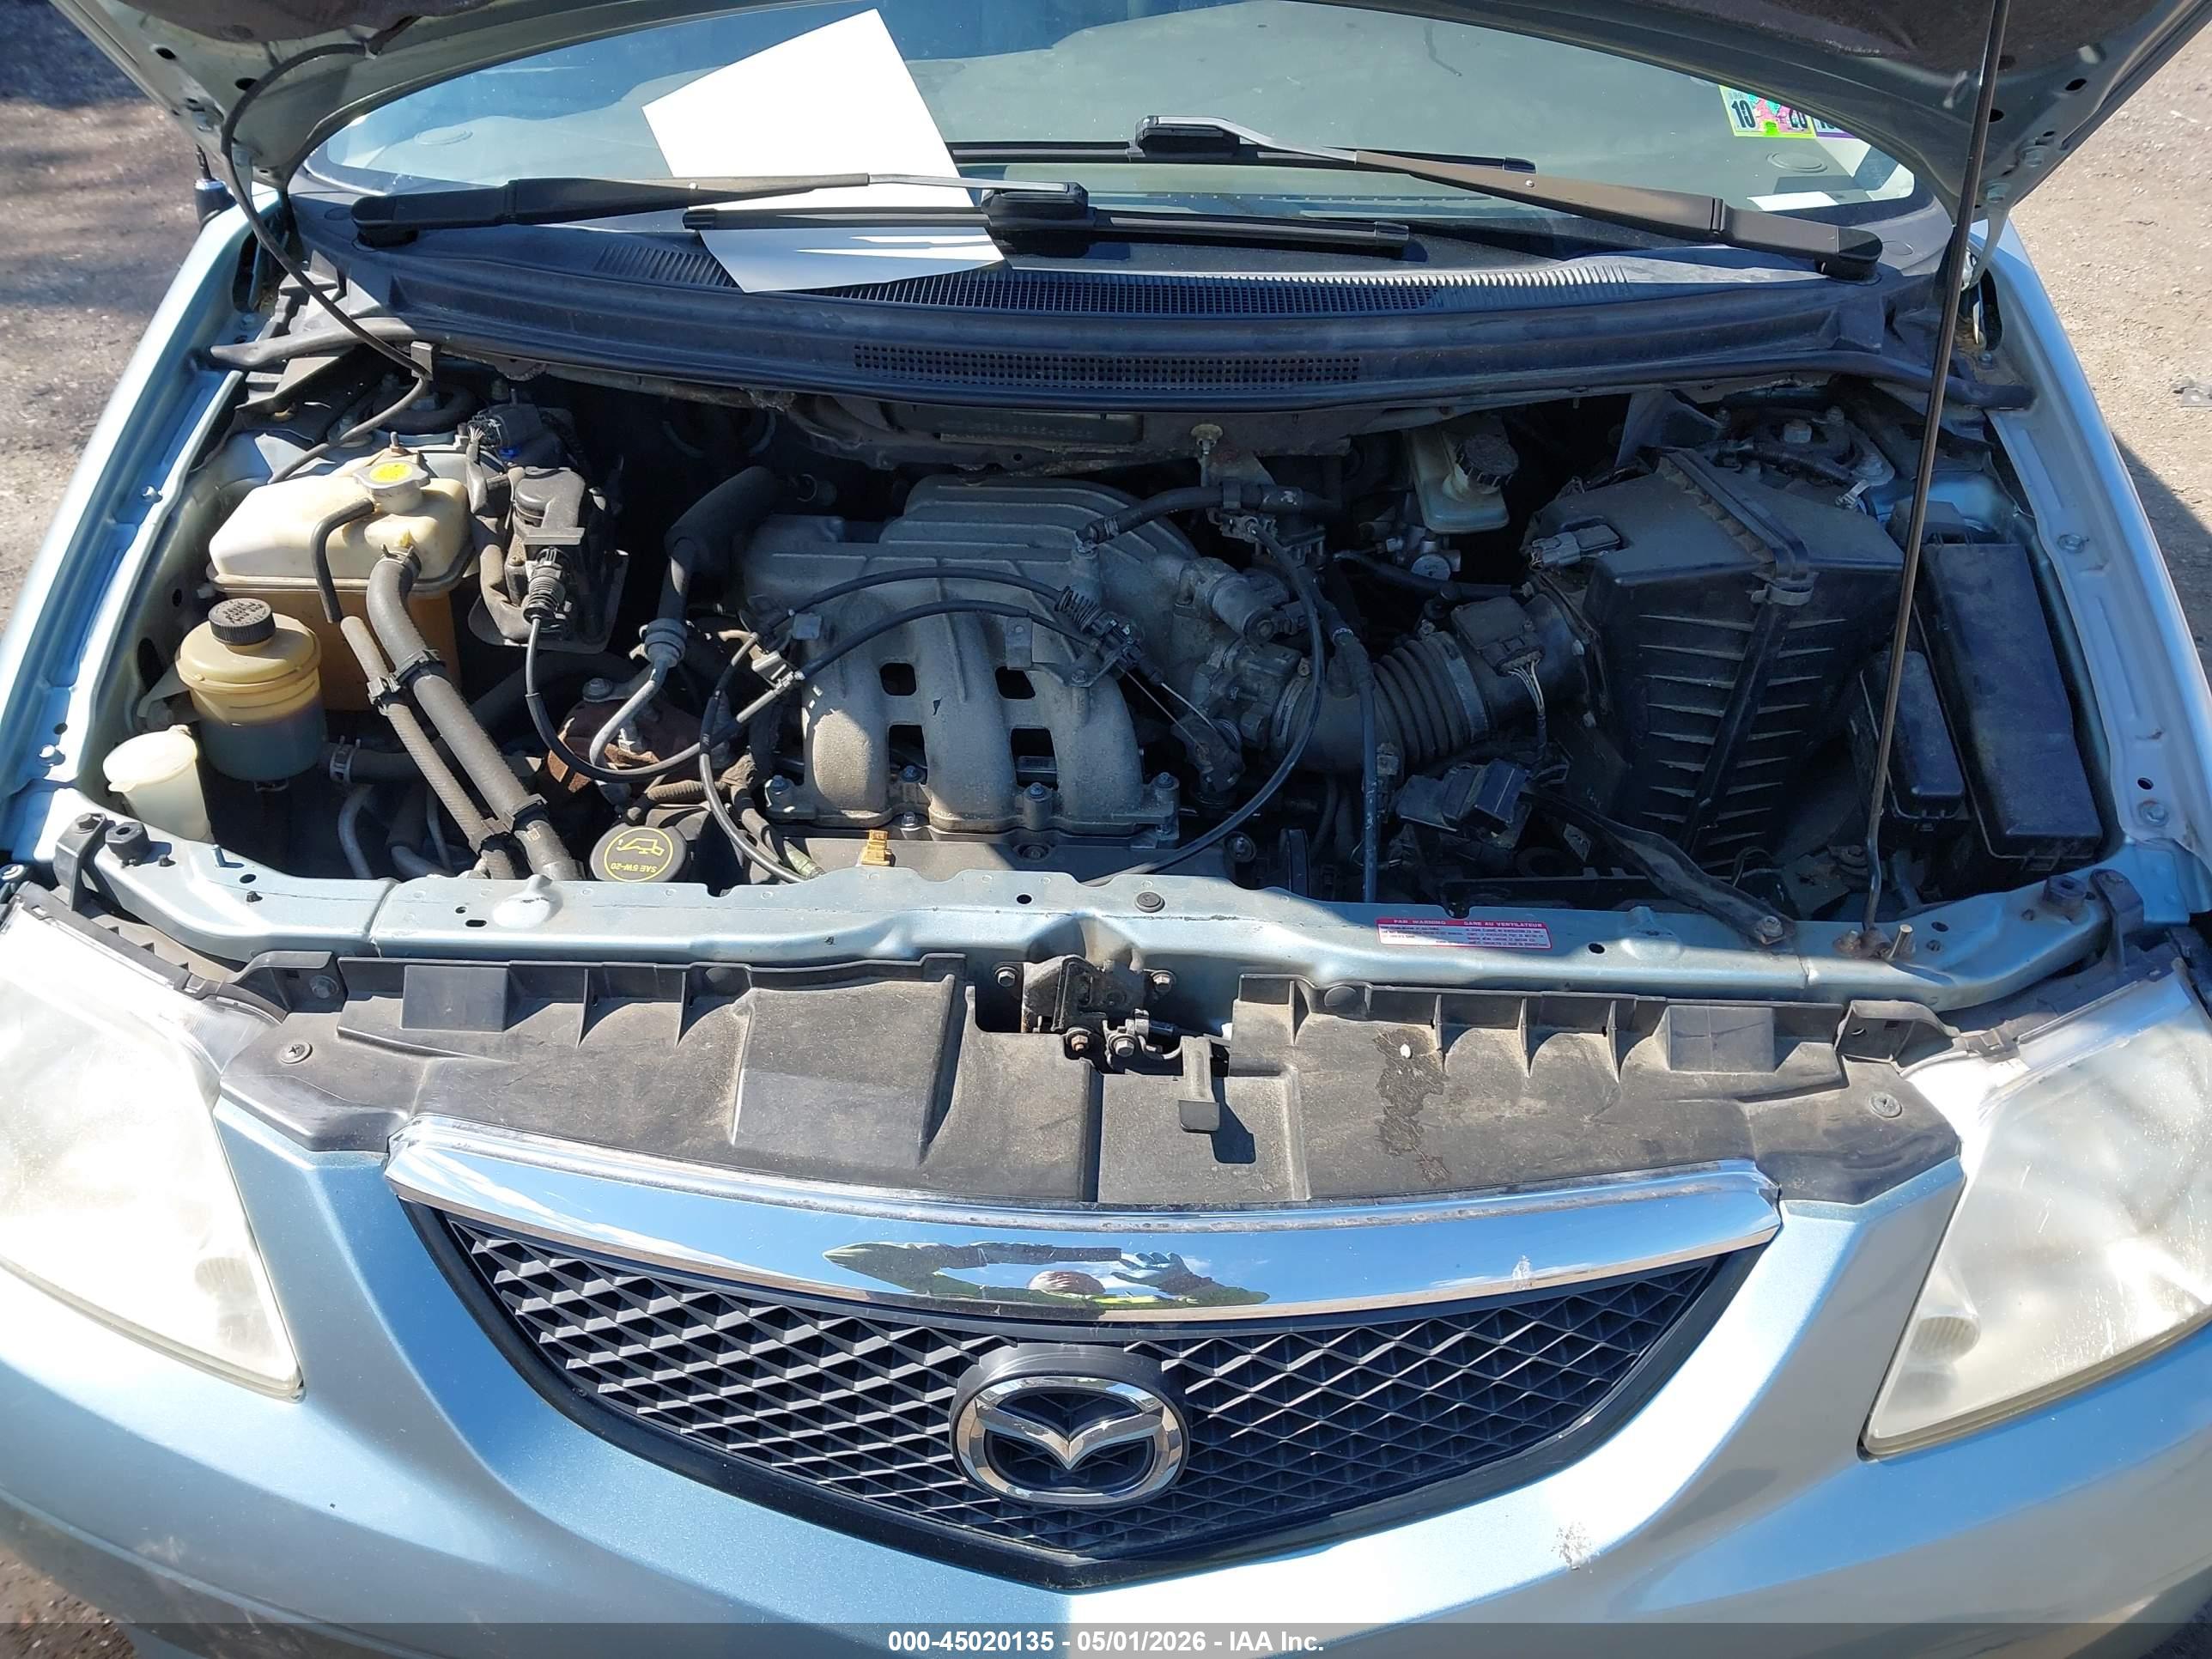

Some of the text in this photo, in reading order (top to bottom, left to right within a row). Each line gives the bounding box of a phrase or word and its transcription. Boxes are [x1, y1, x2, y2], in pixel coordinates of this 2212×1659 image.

[1731, 100, 1756, 129] 10
[611, 862, 658, 873] SAE 5W-20
